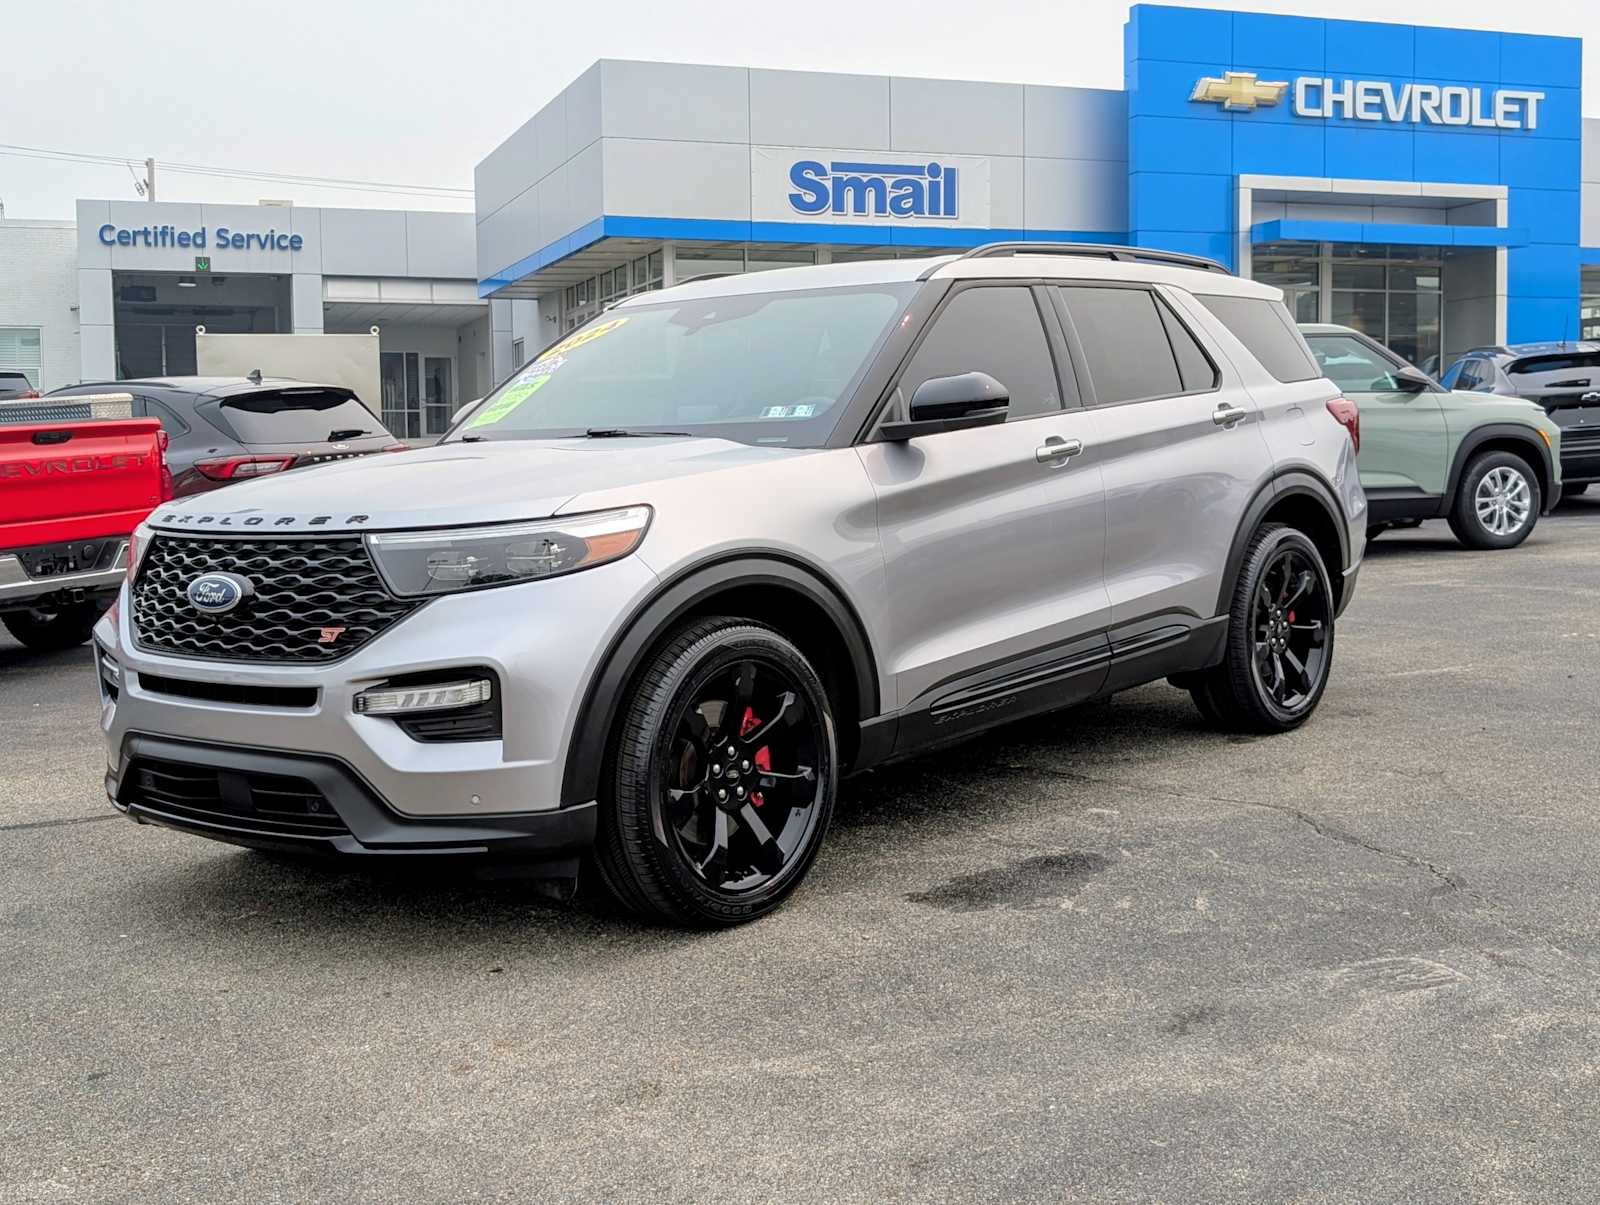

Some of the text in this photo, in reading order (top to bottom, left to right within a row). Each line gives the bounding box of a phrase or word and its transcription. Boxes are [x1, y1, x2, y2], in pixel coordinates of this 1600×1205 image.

[1295, 76, 1545, 129] CHEVROLET
[787, 159, 958, 218] Smail
[99, 224, 304, 251] Certified Service
[161, 514, 370, 526] EXPLORER
[195, 581, 227, 604] Ford
[317, 627, 346, 643] ST
